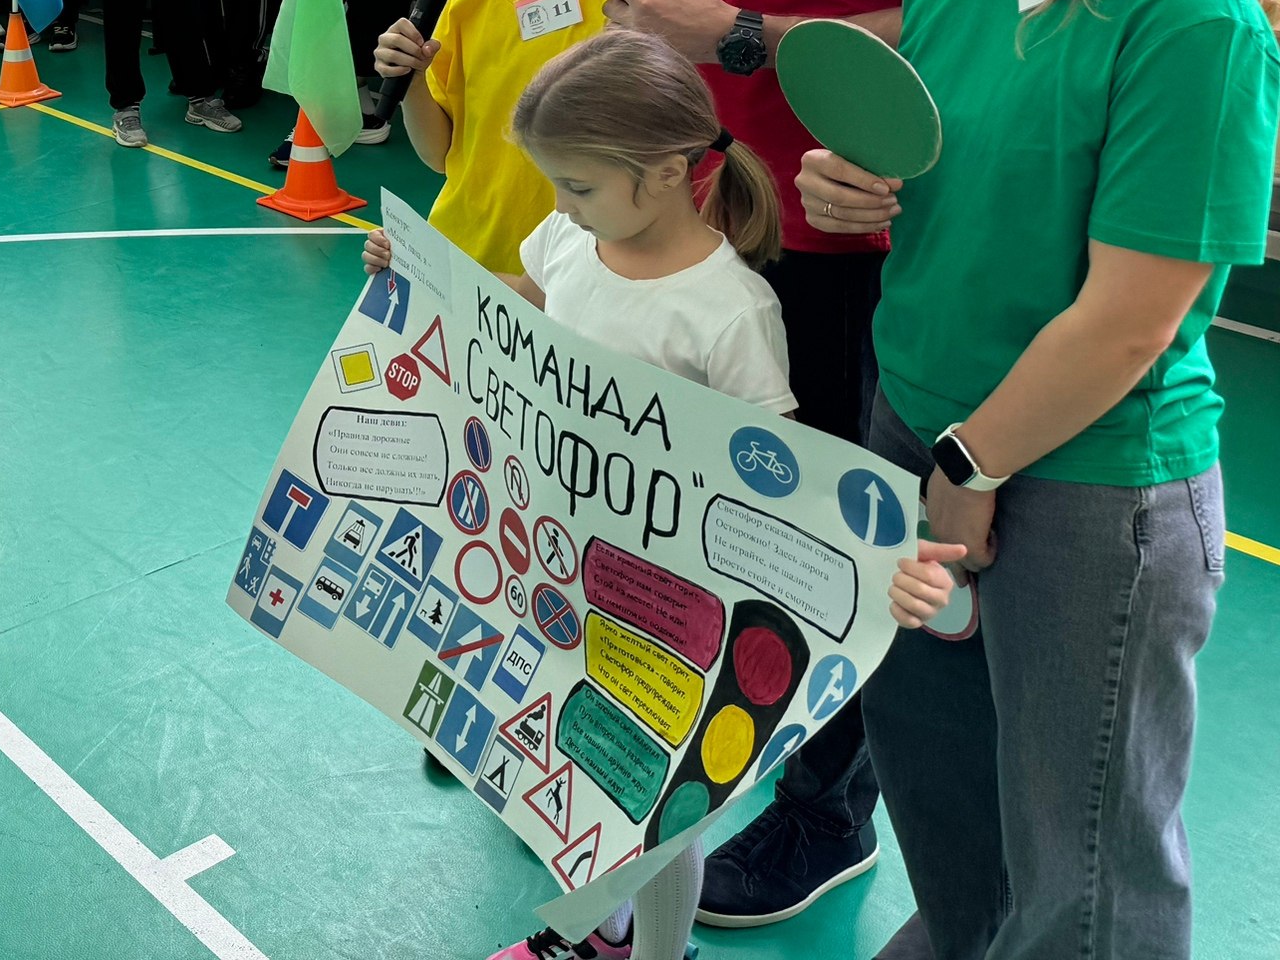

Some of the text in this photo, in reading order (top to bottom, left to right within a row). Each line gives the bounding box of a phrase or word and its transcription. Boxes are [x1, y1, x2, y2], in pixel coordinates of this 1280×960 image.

[552, 0, 572, 17] 11
[388, 362, 419, 390] STOP
[477, 285, 671, 451] КОМАНДА
[356, 414, 408, 428] Наш девиз:
[328, 429, 411, 445] «Правила дорожные
[329, 445, 349, 455] Они
[349, 448, 380, 459] совсем
[381, 452, 391, 460] не
[327, 460, 358, 472] Только
[359, 466, 374, 474] все
[374, 468, 407, 477] должны
[407, 471, 417, 479] их
[325, 477, 363, 490] Никогда
[364, 483, 375, 491] не
[716, 501, 844, 569] Светофор сказал нам строго
[595, 543, 616, 559] Если
[616, 554, 652, 577] красный
[714, 534, 814, 592] Не играйте, не шалите
[715, 518, 830, 581] Осторожно! Здесь дорога
[594, 559, 635, 585] Светофор
[636, 582, 652, 593] нам
[712, 551, 830, 621] Просто стойте и смотрите!
[510, 585, 524, 608] 60
[592, 589, 605, 602] Ты
[593, 574, 614, 590] Стой
[655, 604, 668, 618] Не
[506, 650, 532, 676] ДПС
[619, 633, 652, 653] желтый
[652, 649, 669, 664] свет
[669, 661, 691, 683] горит,
[585, 689, 595, 702] Он
[598, 663, 672, 731] Что он свет переключает
[600, 649, 681, 720] Светофор предупреждает,
[579, 705, 595, 721] Путь
[573, 721, 584, 736] Все
